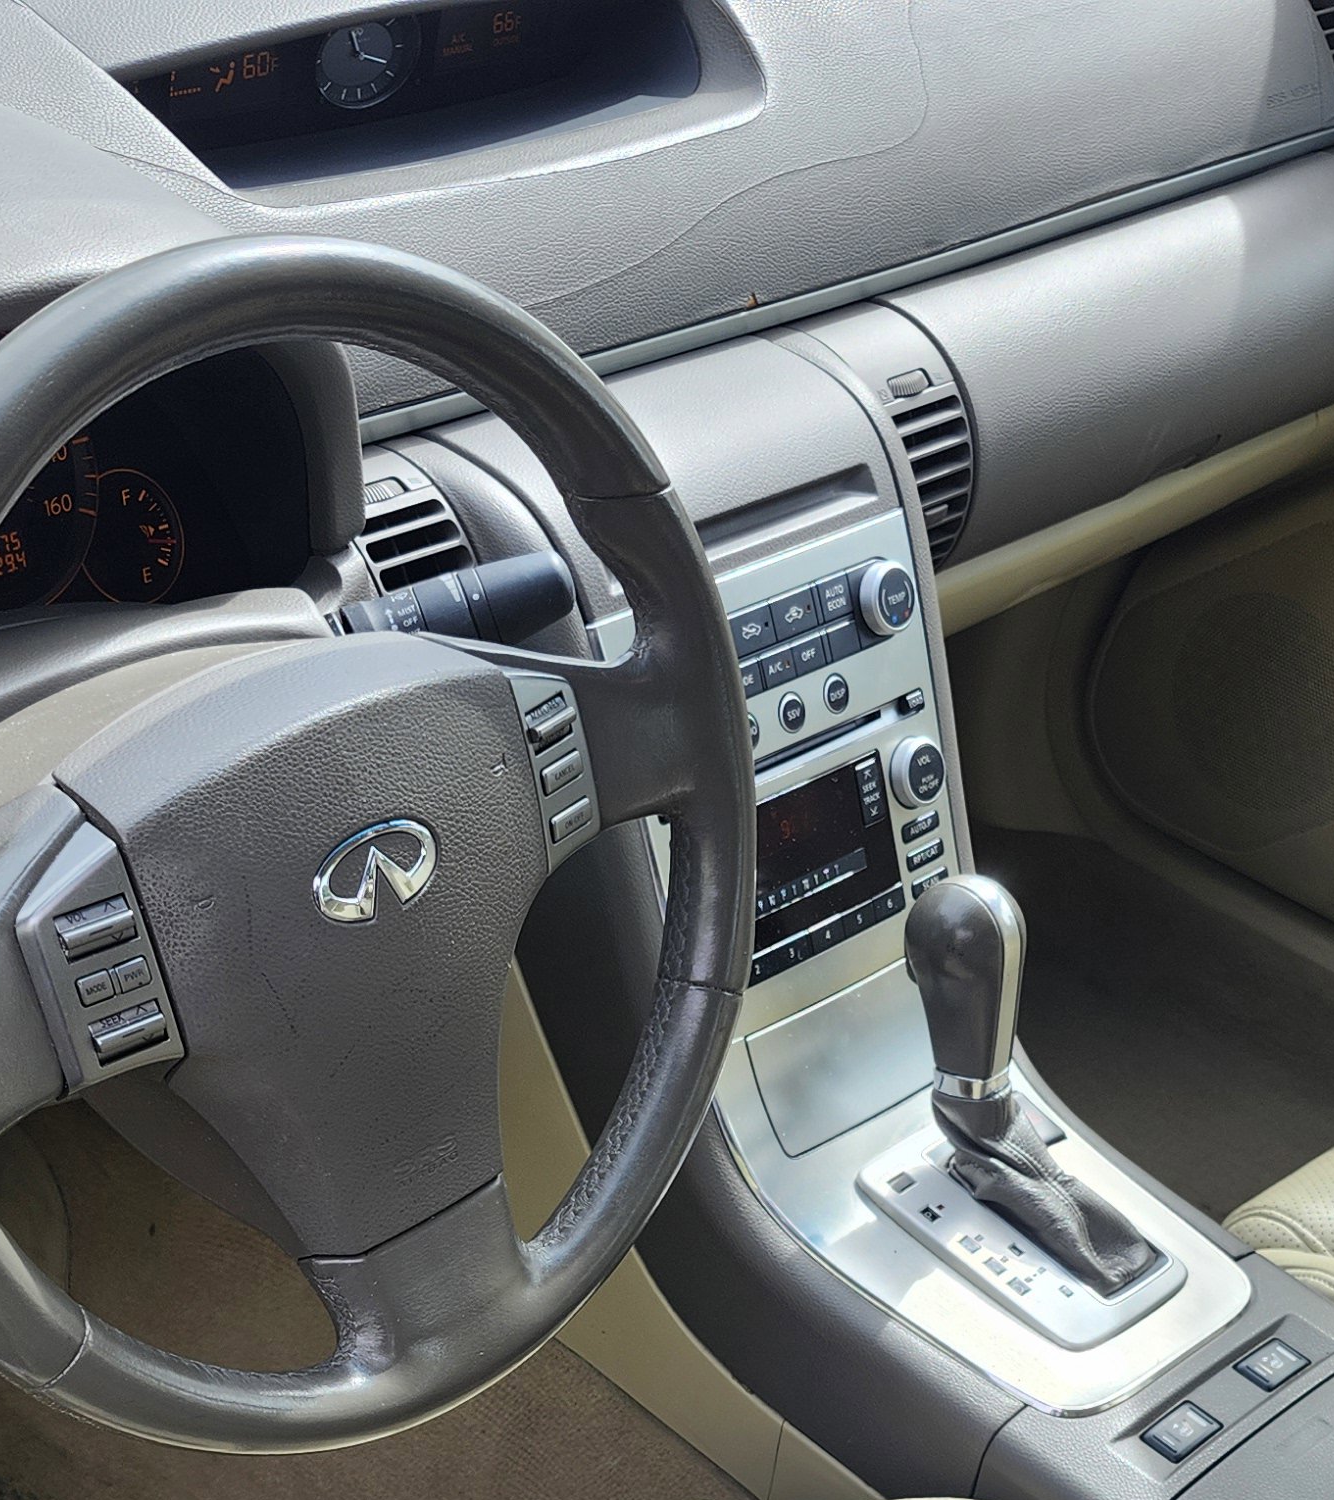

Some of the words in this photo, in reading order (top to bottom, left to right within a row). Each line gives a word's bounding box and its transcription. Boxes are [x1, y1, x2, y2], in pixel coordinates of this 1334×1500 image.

[122, 488, 131, 506] F
[44, 493, 73, 517] 160
[142, 566, 153, 584] E
[825, 584, 845, 599] AUTO
[887, 591, 907, 606] TEMP
[397, 604, 416, 617] MIST
[827, 597, 847, 612] ECON
[402, 616, 419, 628] OFF
[801, 648, 817, 662] OFF
[768, 661, 784, 676] A/C
[829, 688, 846, 702] DISP
[917, 754, 932, 767] VOL
[554, 764, 577, 782] CANCEL
[862, 780, 878, 794] SEEK
[886, 898, 894, 909] 6
[65, 911, 87, 925] VOL
[856, 914, 863, 925] 5
[825, 930, 832, 940] 4
[788, 948, 796, 959] 3
[124, 968, 145, 983] PWR
[754, 964, 761, 975] 2
[85, 981, 108, 996] MODE
[100, 1013, 126, 1029] SEEK
